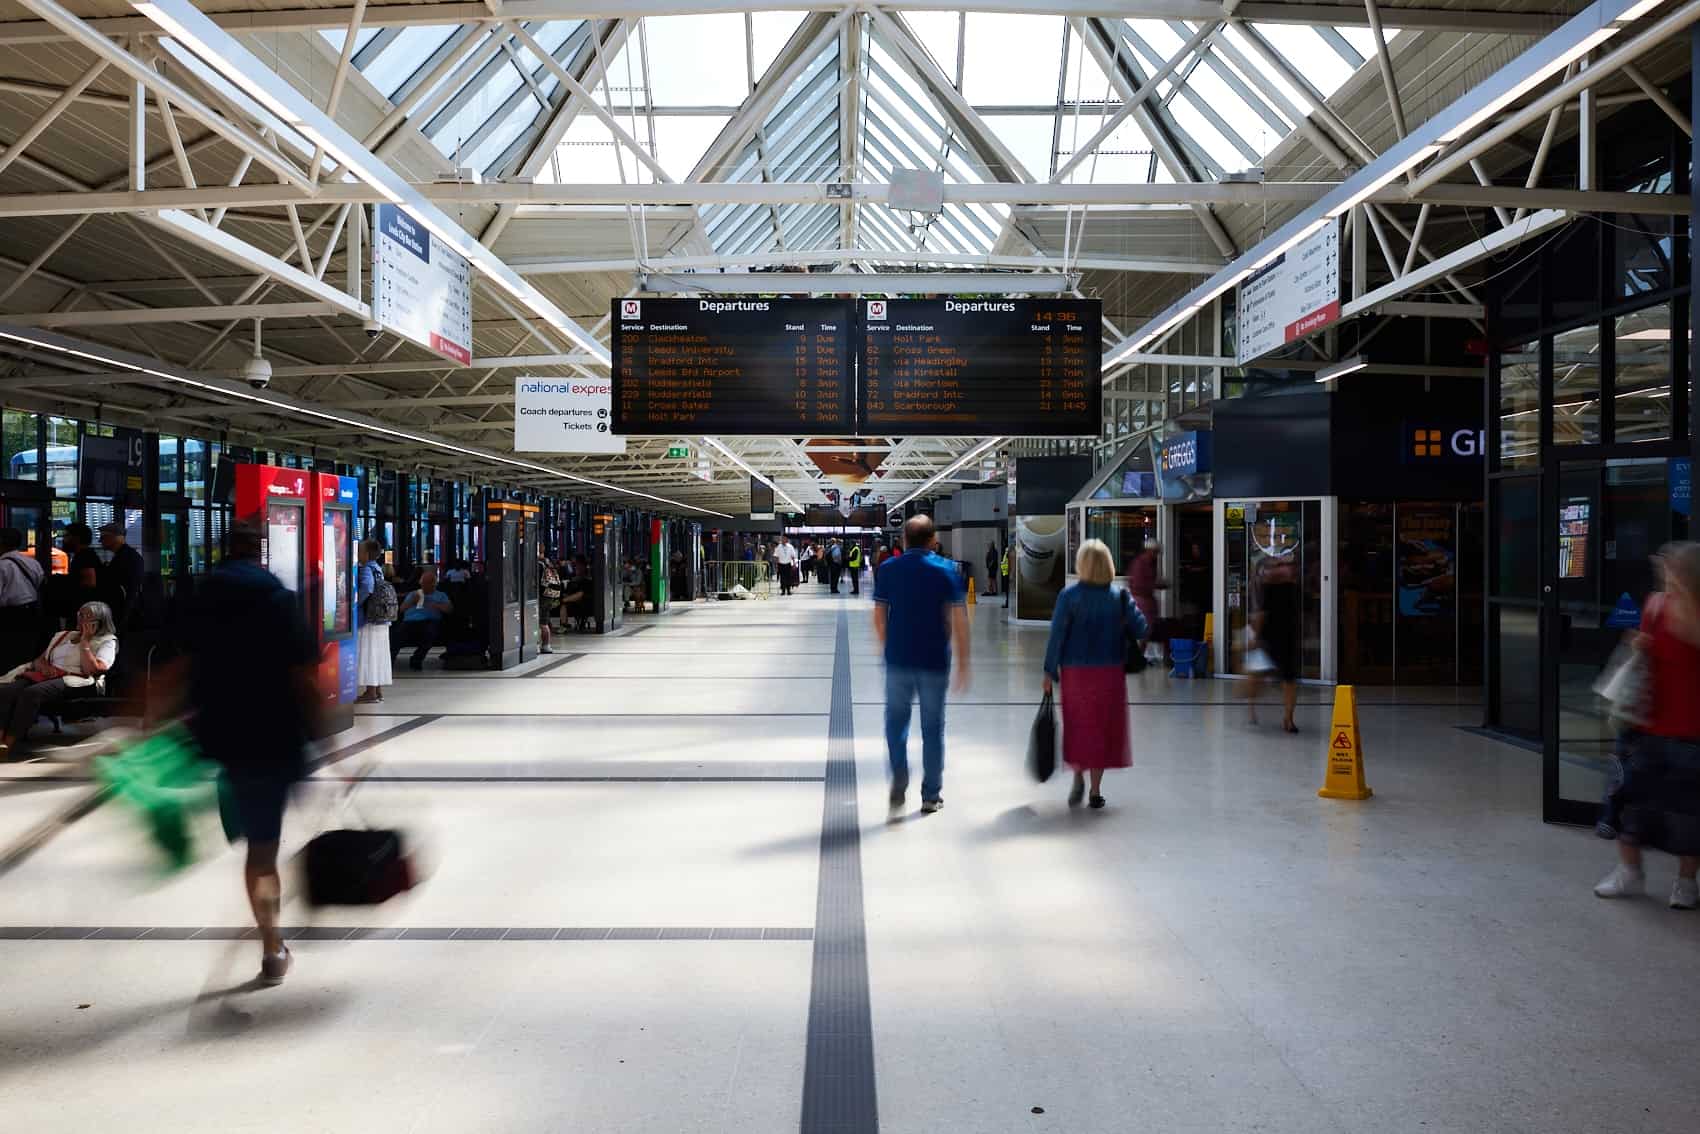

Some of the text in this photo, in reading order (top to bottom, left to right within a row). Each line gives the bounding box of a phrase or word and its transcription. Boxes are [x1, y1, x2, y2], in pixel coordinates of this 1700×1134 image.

[699, 300, 770, 314] Departures
[945, 301, 1016, 315] Departures
[816, 335, 834, 343] Due
[682, 346, 735, 355] University
[816, 346, 834, 354] Due
[703, 368, 743, 377] Airport
[521, 382, 569, 393] national
[549, 409, 592, 417] departures
[1168, 440, 1196, 469] GREGGS
